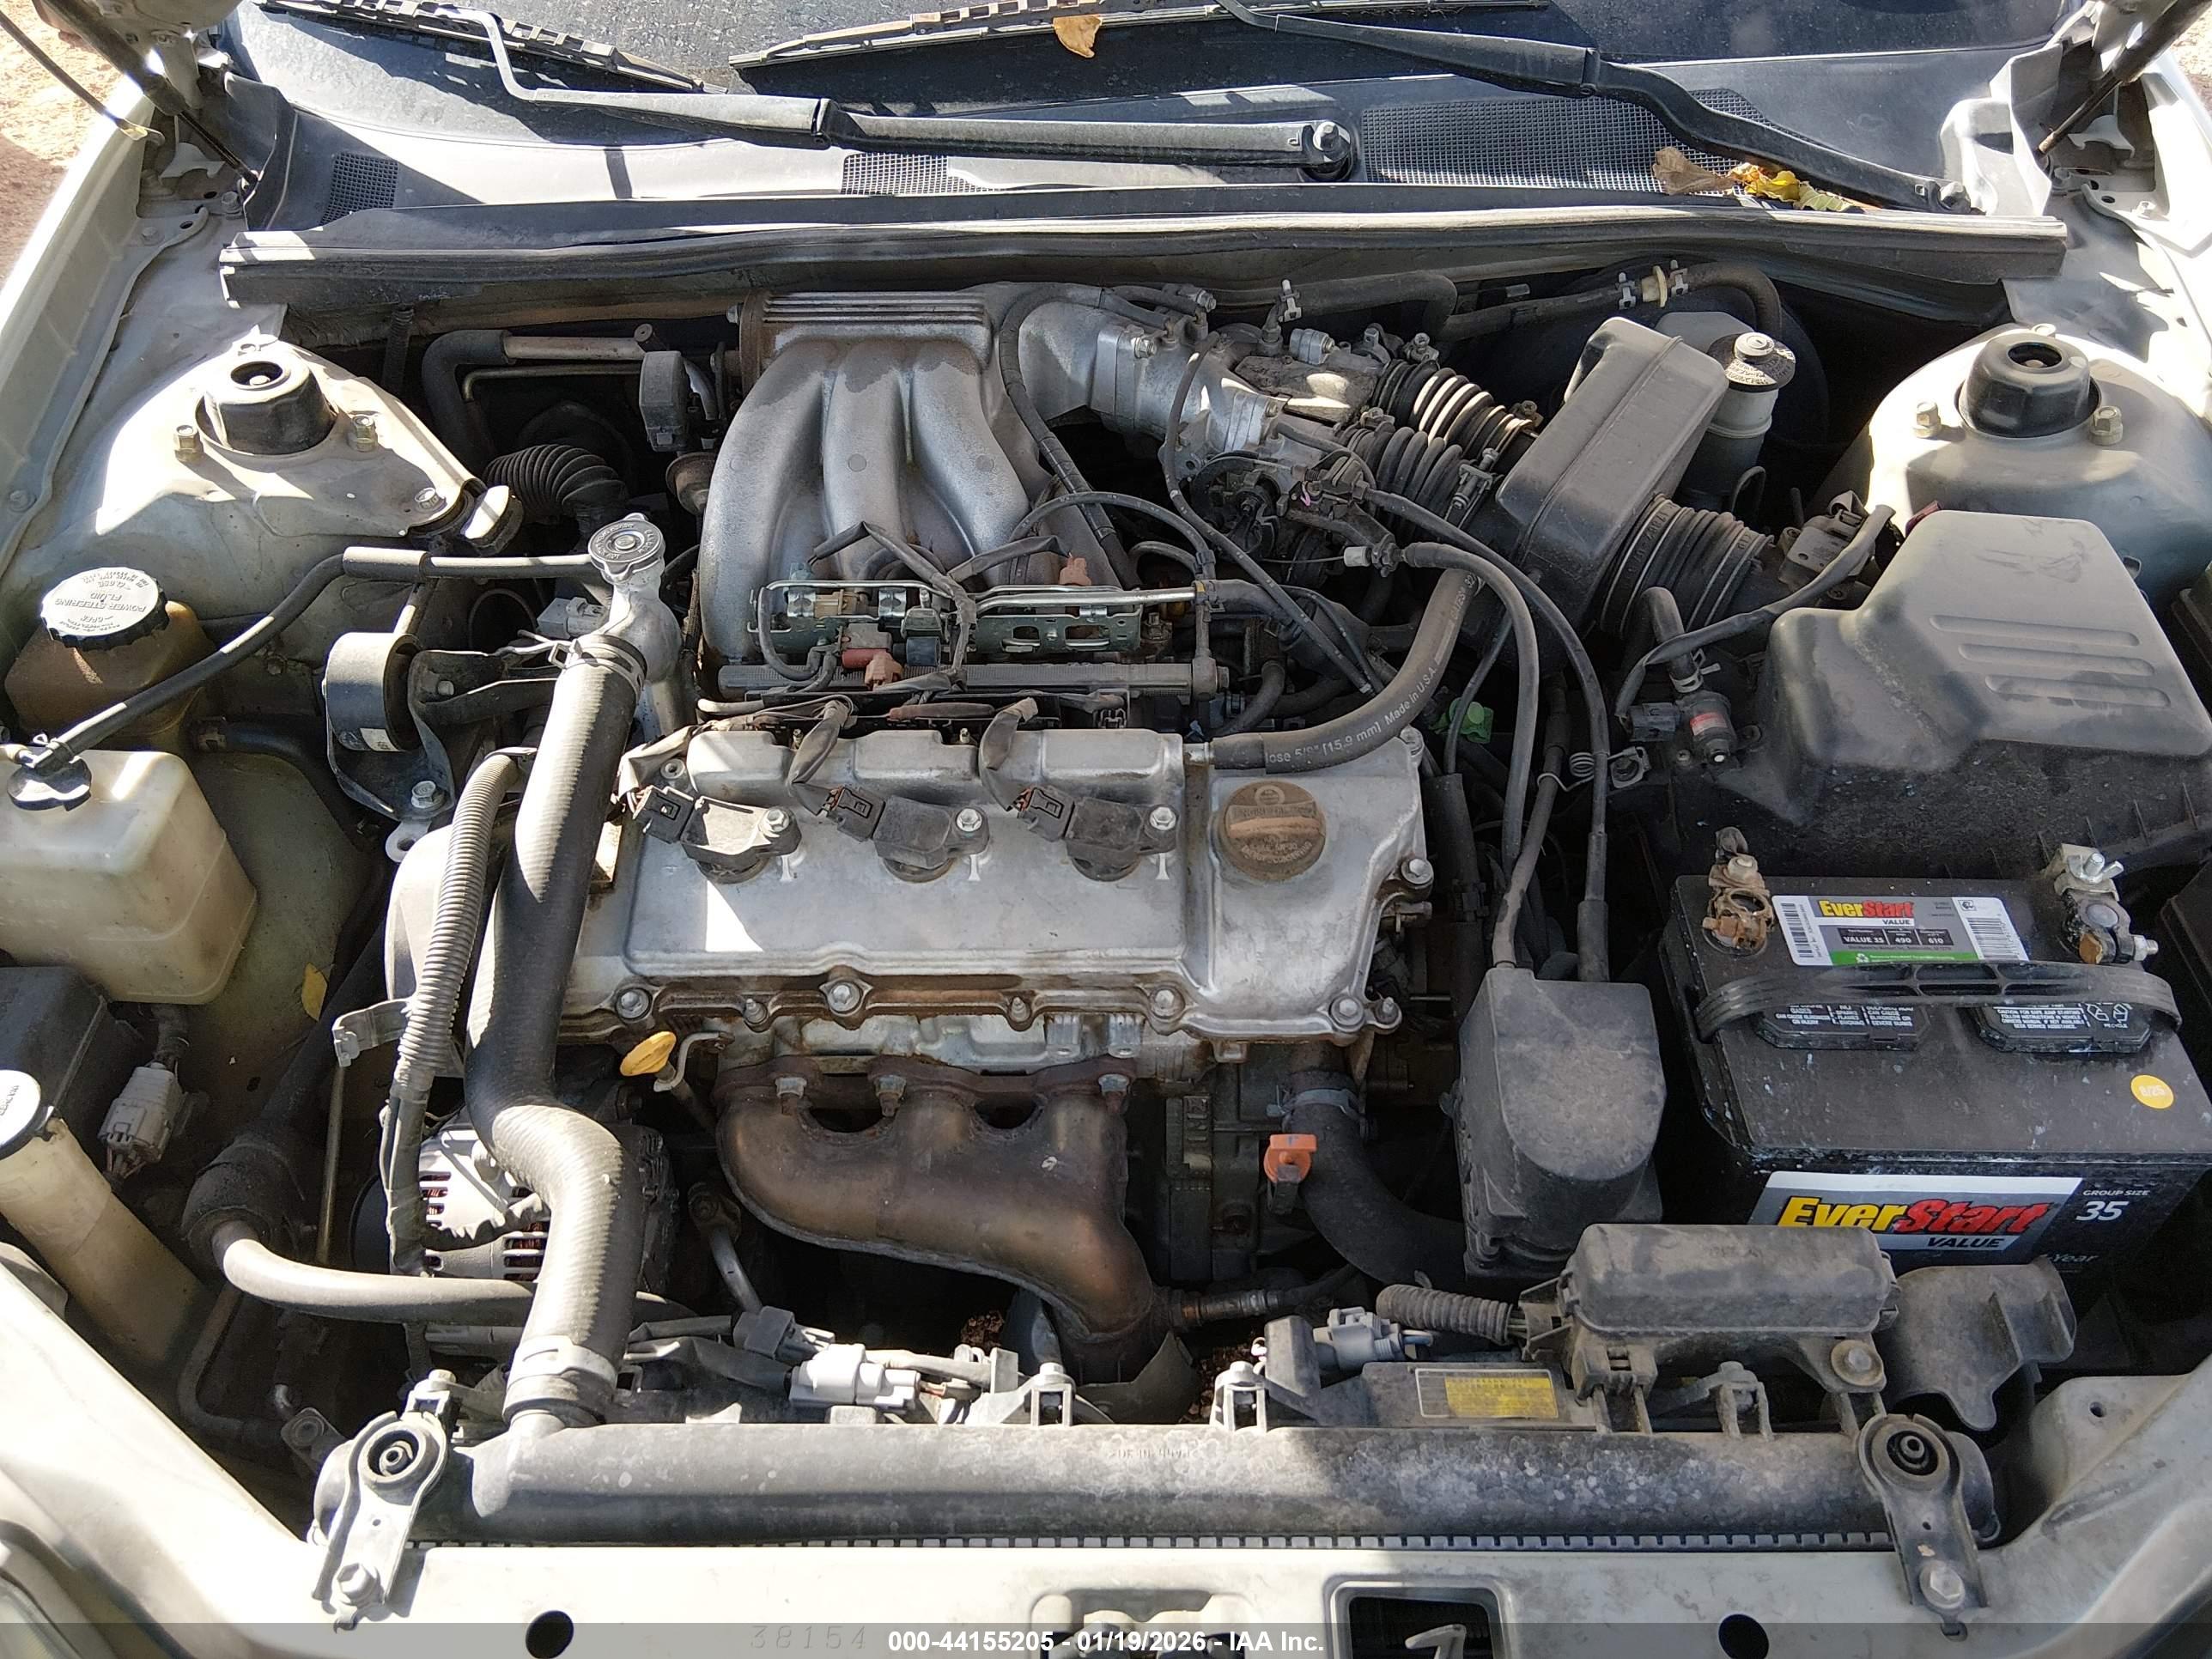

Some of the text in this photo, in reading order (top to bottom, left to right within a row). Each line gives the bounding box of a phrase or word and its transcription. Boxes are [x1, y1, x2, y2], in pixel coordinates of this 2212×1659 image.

[54, 599, 147, 613] POWER STEERING
[89, 592, 123, 601] FLUID
[1356, 721, 1382, 743] mm]
[1384, 701, 1411, 726] Made
[1410, 691, 1419, 704] in
[1818, 899, 1915, 918] EverStart
[1778, 1195, 2053, 1235] EverStart
[2075, 1200, 2130, 1221] 35
[1926, 1237, 2005, 1249] VALUE
[2047, 1254, 2100, 1263] -Year
[750, 1625, 866, 1650] 38154
